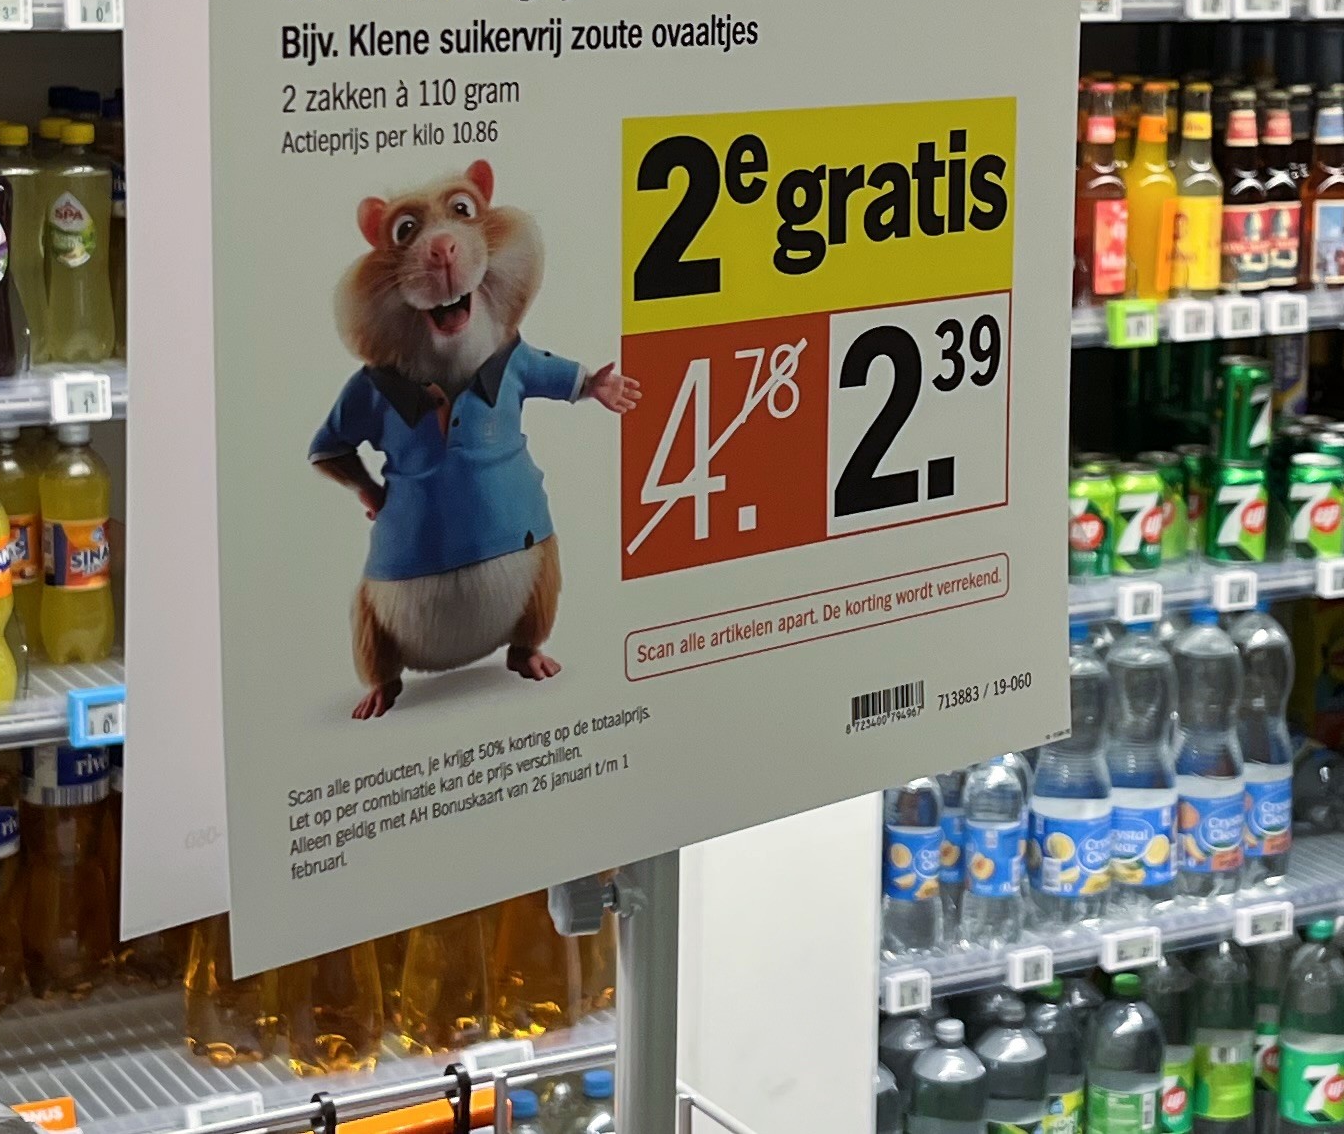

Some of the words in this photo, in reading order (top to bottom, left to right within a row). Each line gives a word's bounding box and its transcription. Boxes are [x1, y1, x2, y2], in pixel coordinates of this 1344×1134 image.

[281, 22, 339, 67] Bijv.
[349, 21, 430, 57] Klene
[439, 17, 562, 58] suikervrij
[570, 20, 643, 50] zoute
[651, 14, 759, 54] ovaaltjes
[281, 126, 370, 155] Actieprijs
[375, 129, 407, 153] per
[412, 122, 445, 146] kilo
[452, 119, 499, 144] 10.86
[282, 84, 296, 113] 2
[305, 81, 387, 112] zakken
[395, 79, 409, 108] à
[419, 77, 456, 107] 110
[463, 80, 520, 111] gram
[633, 132, 769, 302] 2e
[772, 128, 1008, 275] gratis
[834, 313, 1002, 518] 2.39
[636, 642, 675, 664] Scan
[679, 632, 706, 655] alle
[710, 620, 773, 648] artikelen
[777, 608, 819, 635] apart.
[822, 603, 841, 623] De
[844, 592, 893, 618] korting
[895, 582, 934, 606] wordt
[936, 566, 1002, 597] verrekend.
[937, 685, 980, 711] 713883
[982, 682, 990, 699] /
[992, 671, 1033, 696] 19-060
[288, 786, 323, 808] Scan
[326, 777, 351, 798] alle
[354, 762, 425, 794] producten,
[427, 755, 440, 777] je
[443, 747, 476, 770] krijgt
[478, 739, 505, 761] 50%
[508, 729, 551, 753] korting
[554, 725, 570, 742] op
[573, 719, 589, 737] de
[591, 705, 651, 732] totaalprijs.
[289, 811, 310, 833] Let
[313, 808, 332, 827] op
[335, 801, 359, 823] per
[362, 781, 437, 813] combinatie
[439, 775, 464, 793] kan
[466, 769, 484, 787] de
[486, 764, 514, 785] prijs
[515, 745, 583, 774] verschillen.
[290, 833, 333, 857] Alleen
[335, 824, 377, 849] geldig
[379, 811, 407, 834] met
[409, 805, 428, 826] AH
[431, 787, 505, 820] Bonuskaart
[506, 781, 529, 800] van
[531, 774, 548, 793] 26
[550, 764, 592, 792] januari
[595, 757, 619, 778] t/m
[622, 752, 630, 770] 1
